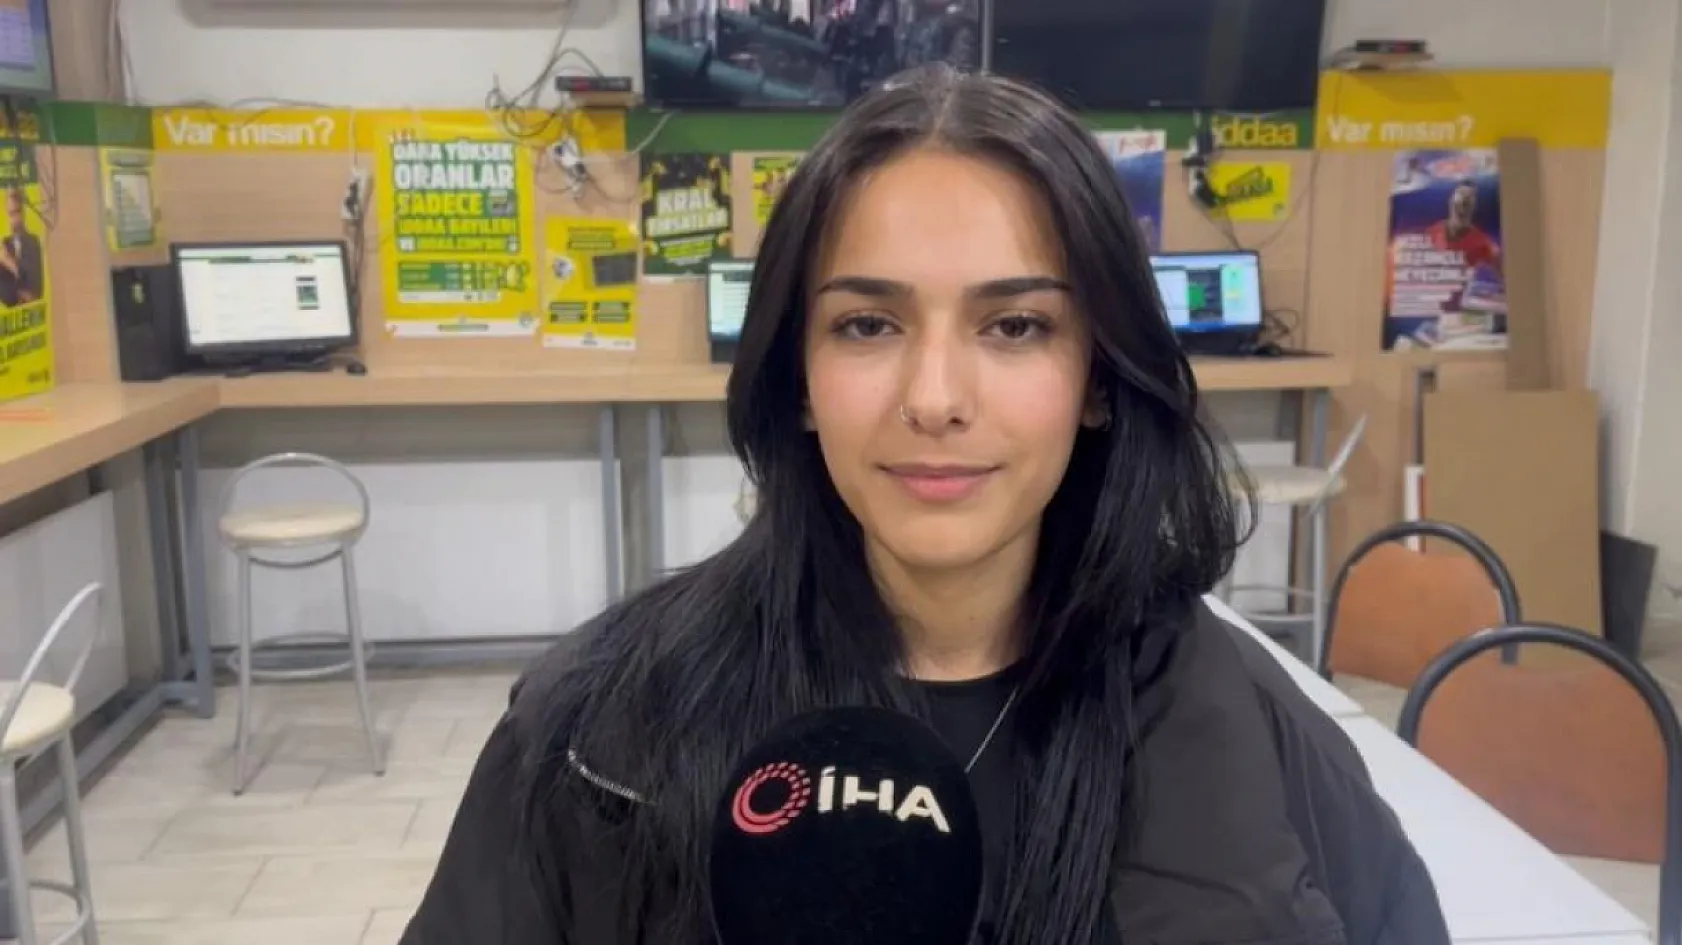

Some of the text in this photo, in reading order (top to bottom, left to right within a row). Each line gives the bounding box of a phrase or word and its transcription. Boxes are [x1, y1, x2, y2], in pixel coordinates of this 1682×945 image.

[163, 114, 217, 146] Var
[1211, 114, 1298, 147] iddaa
[1325, 114, 1373, 143] Var
[394, 162, 515, 190] ORANLAR
[396, 190, 484, 216] SADECE
[656, 187, 718, 214] KRAL
[817, 765, 951, 833] İHA
